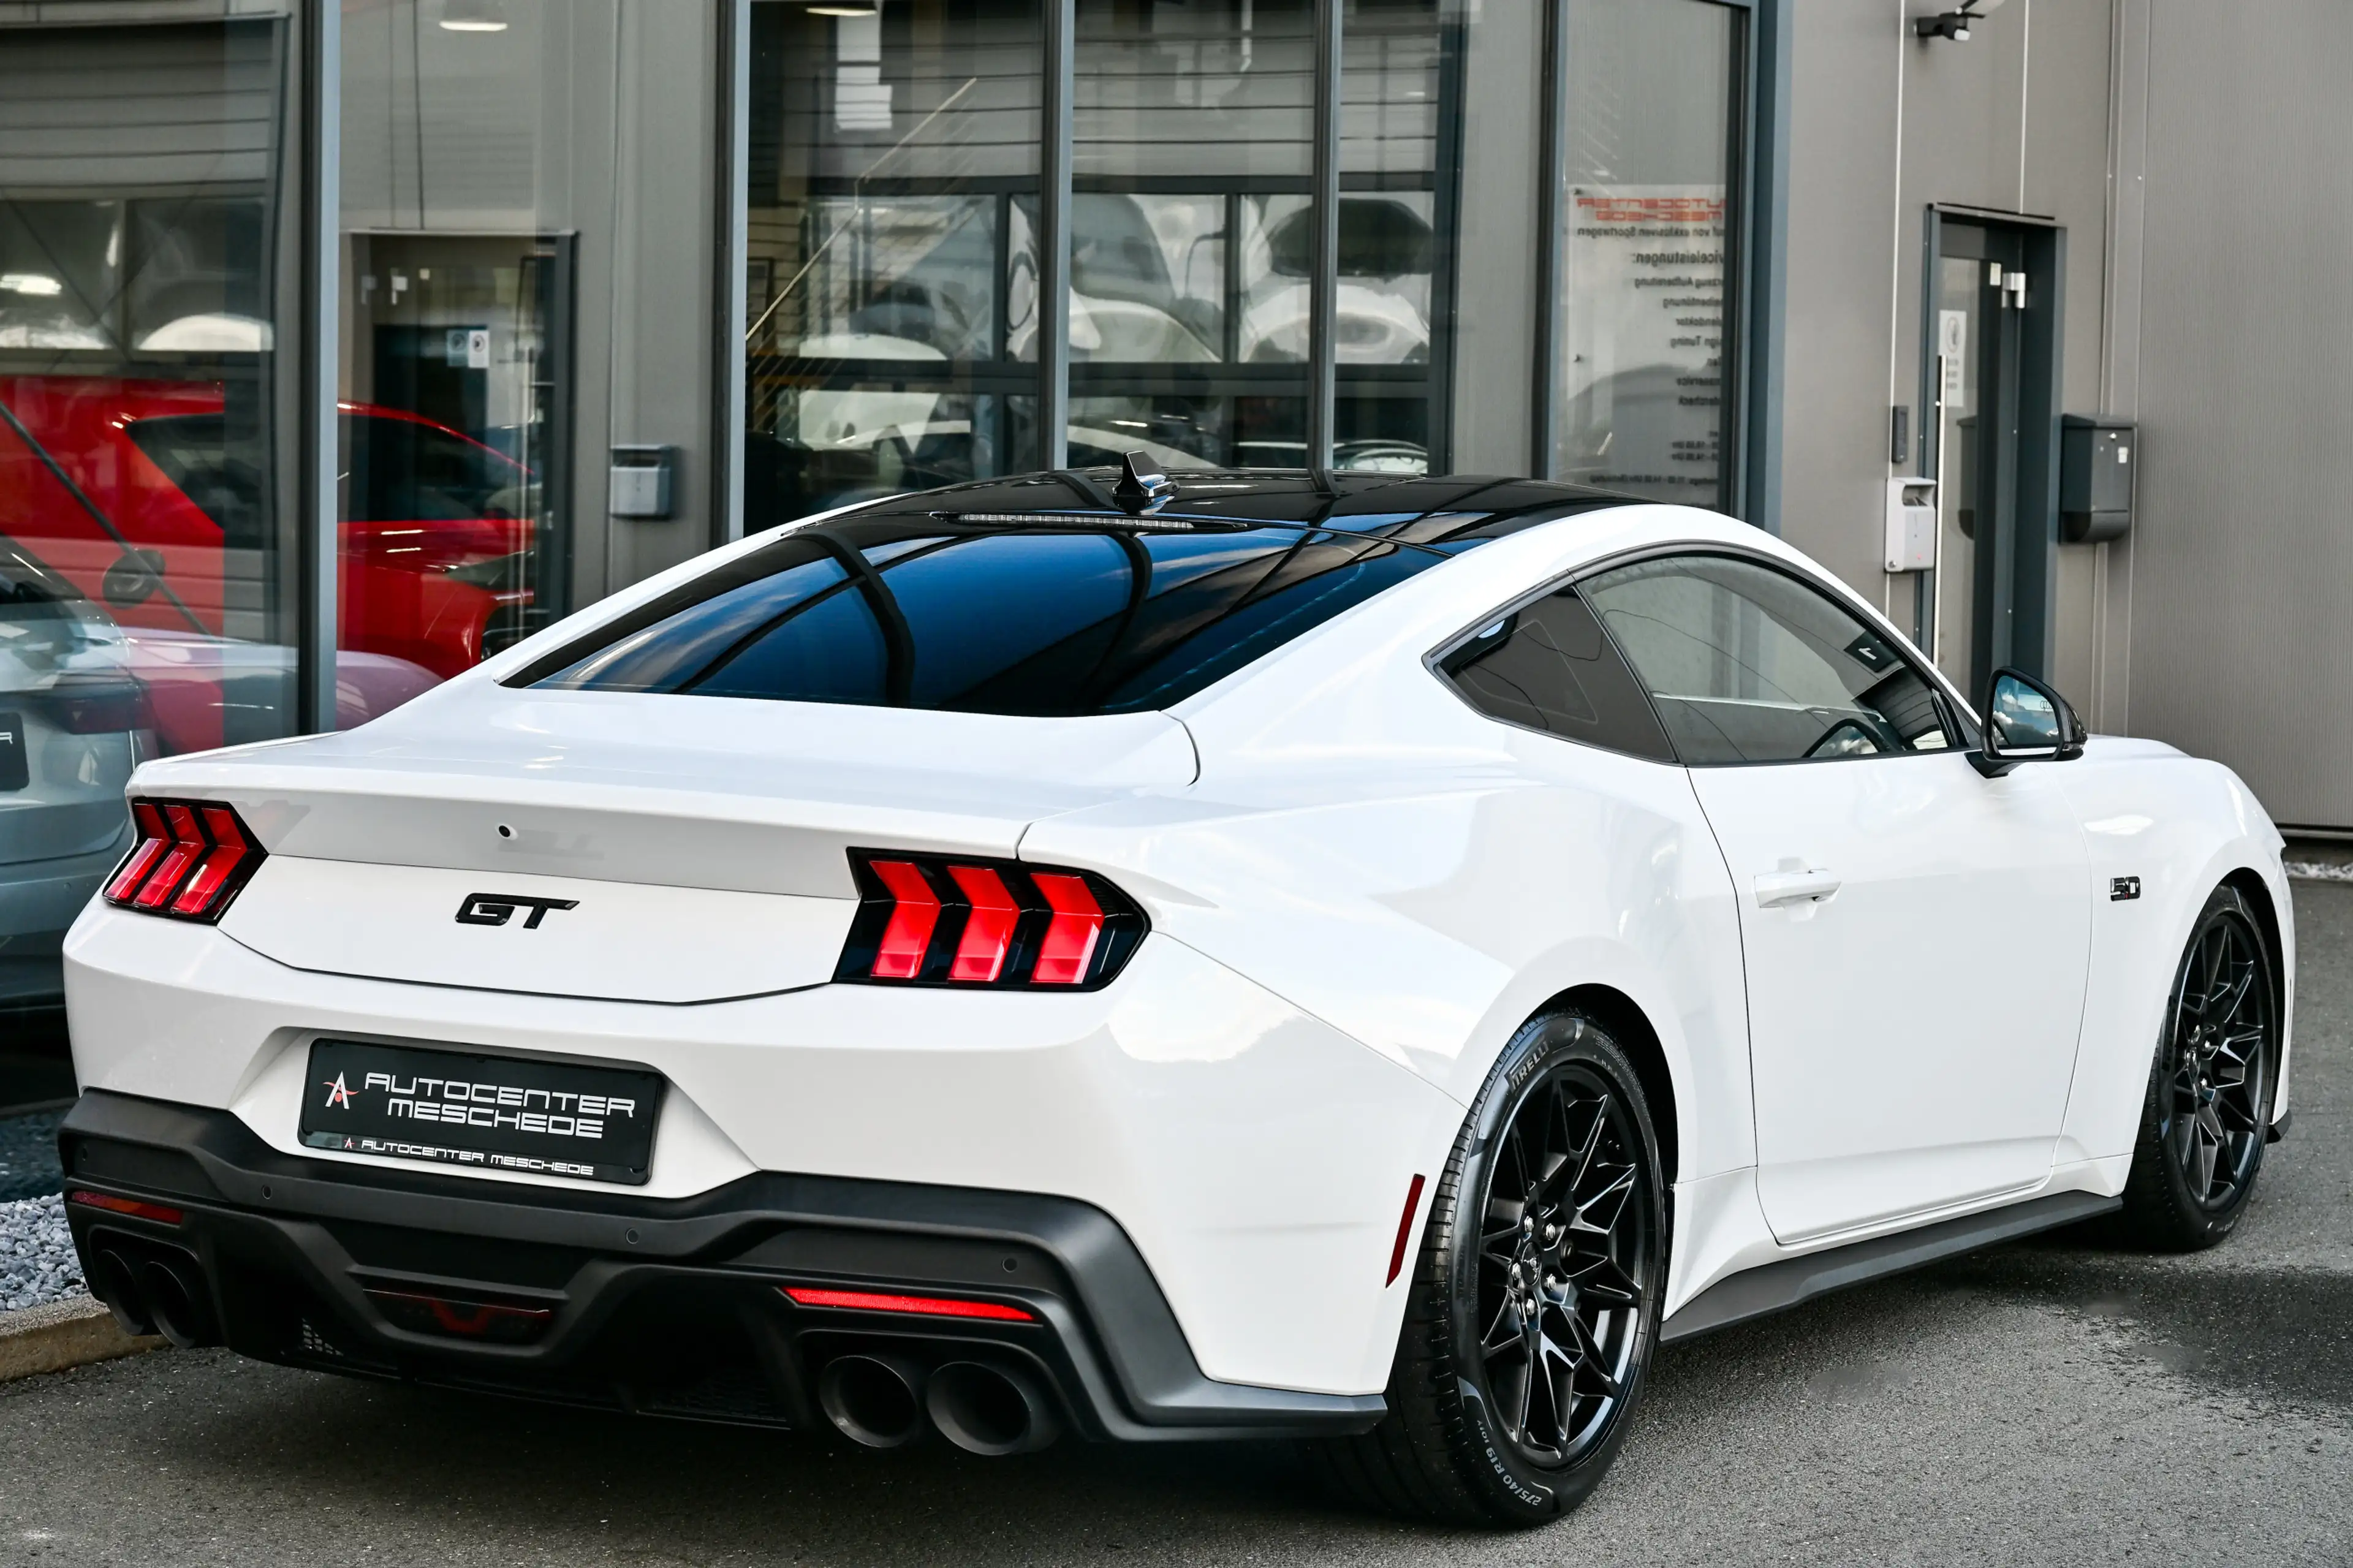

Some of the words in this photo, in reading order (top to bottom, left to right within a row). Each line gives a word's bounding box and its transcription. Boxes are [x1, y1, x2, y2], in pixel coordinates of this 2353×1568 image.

[455, 892, 580, 930] GT
[1510, 1040, 1550, 1091] PIRELLI
[365, 1072, 635, 1118] AUTOCENTER
[387, 1097, 604, 1139] MESCHEDE
[361, 1139, 484, 1162] AUTOCENTER
[490, 1154, 594, 1176] MESCHEDE
[1486, 1447, 1505, 1474] R19
[1503, 1474, 1542, 1506] 275/40
